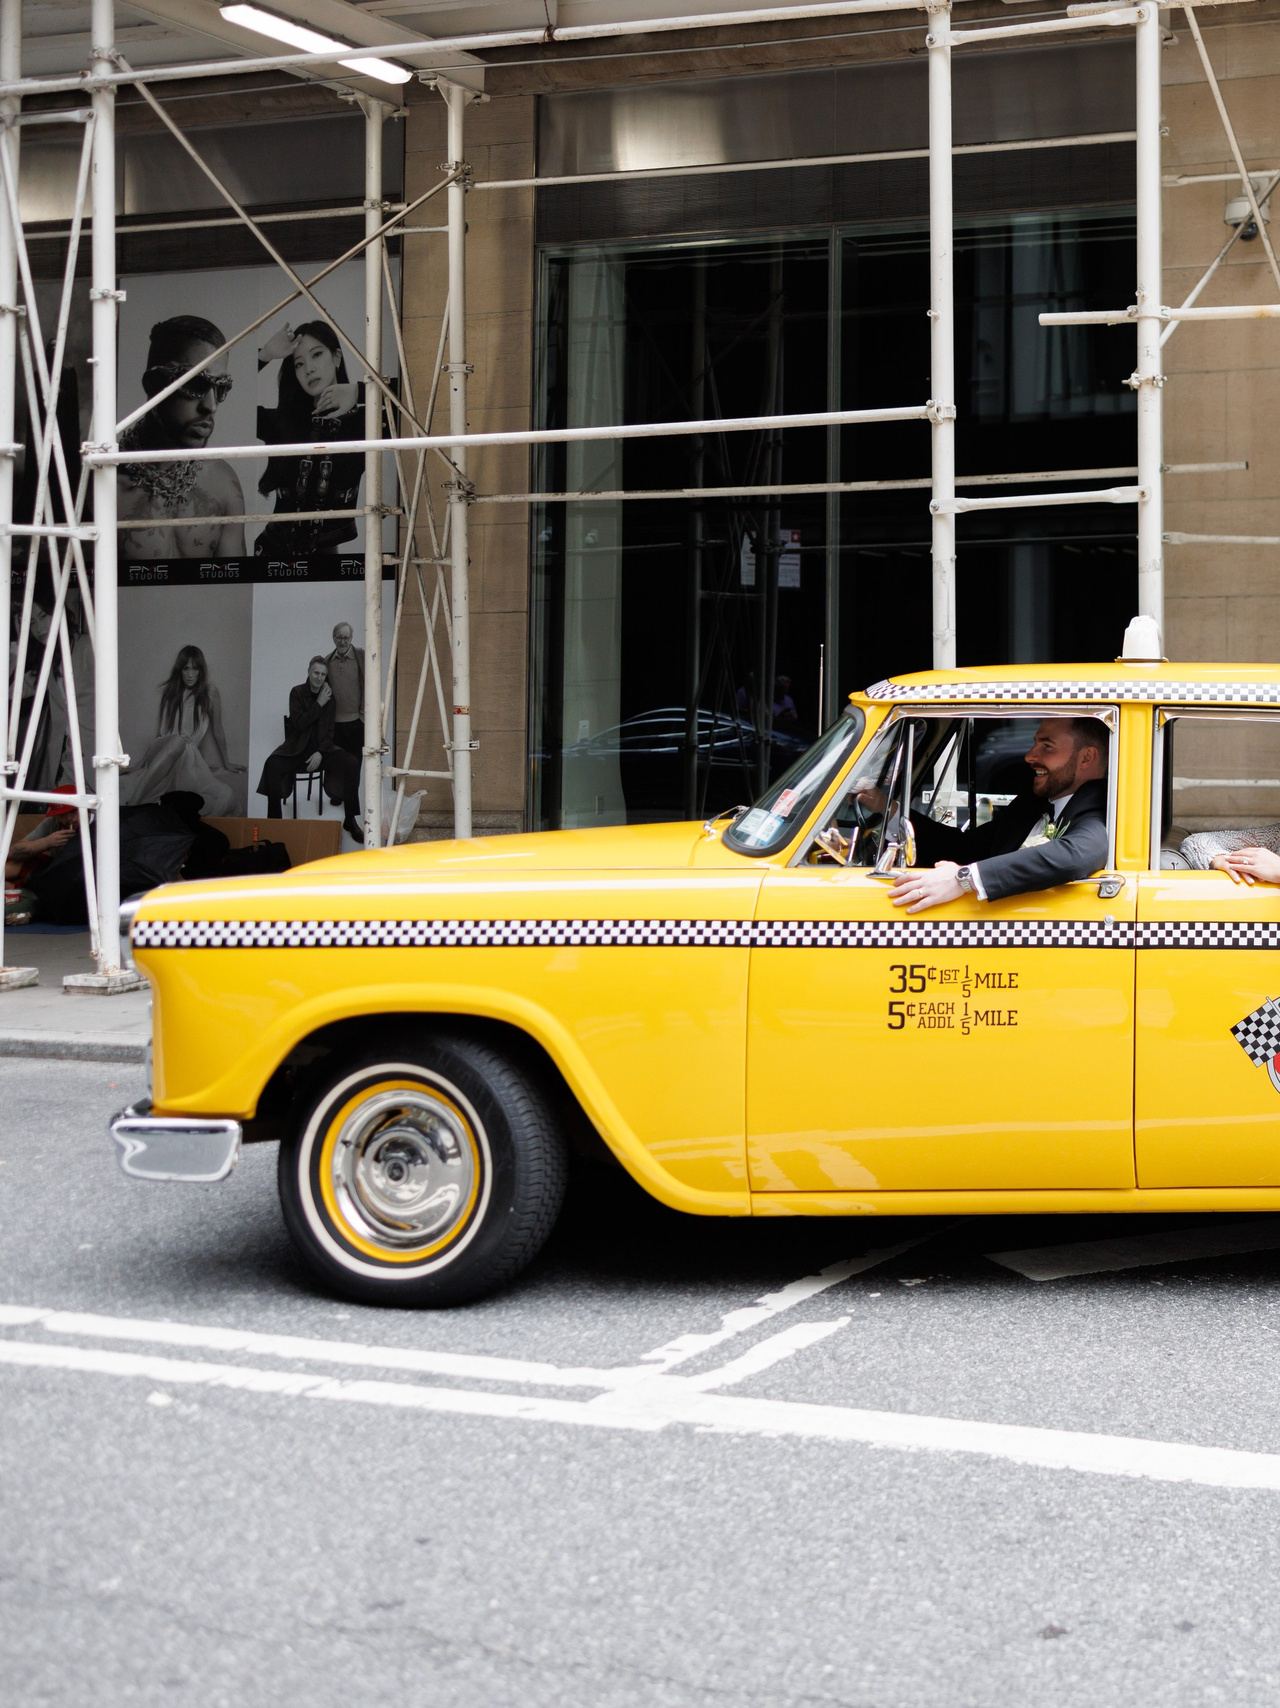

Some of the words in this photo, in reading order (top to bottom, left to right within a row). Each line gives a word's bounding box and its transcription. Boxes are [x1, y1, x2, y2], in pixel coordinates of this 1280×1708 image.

[129, 564, 169, 573] PMC
[199, 562, 240, 571] PMC
[267, 560, 309, 569] PMC
[199, 570, 240, 579] STUDIOS
[267, 568, 309, 577] STUDIOS
[341, 567, 365, 576] STUD
[129, 572, 169, 581] STUDIOS
[939, 969, 960, 984] 1ST
[974, 972, 1019, 989] MILE
[918, 1002, 955, 1015] EACH
[973, 1010, 1018, 1026] MILE
[917, 1016, 955, 1029] ADDL
